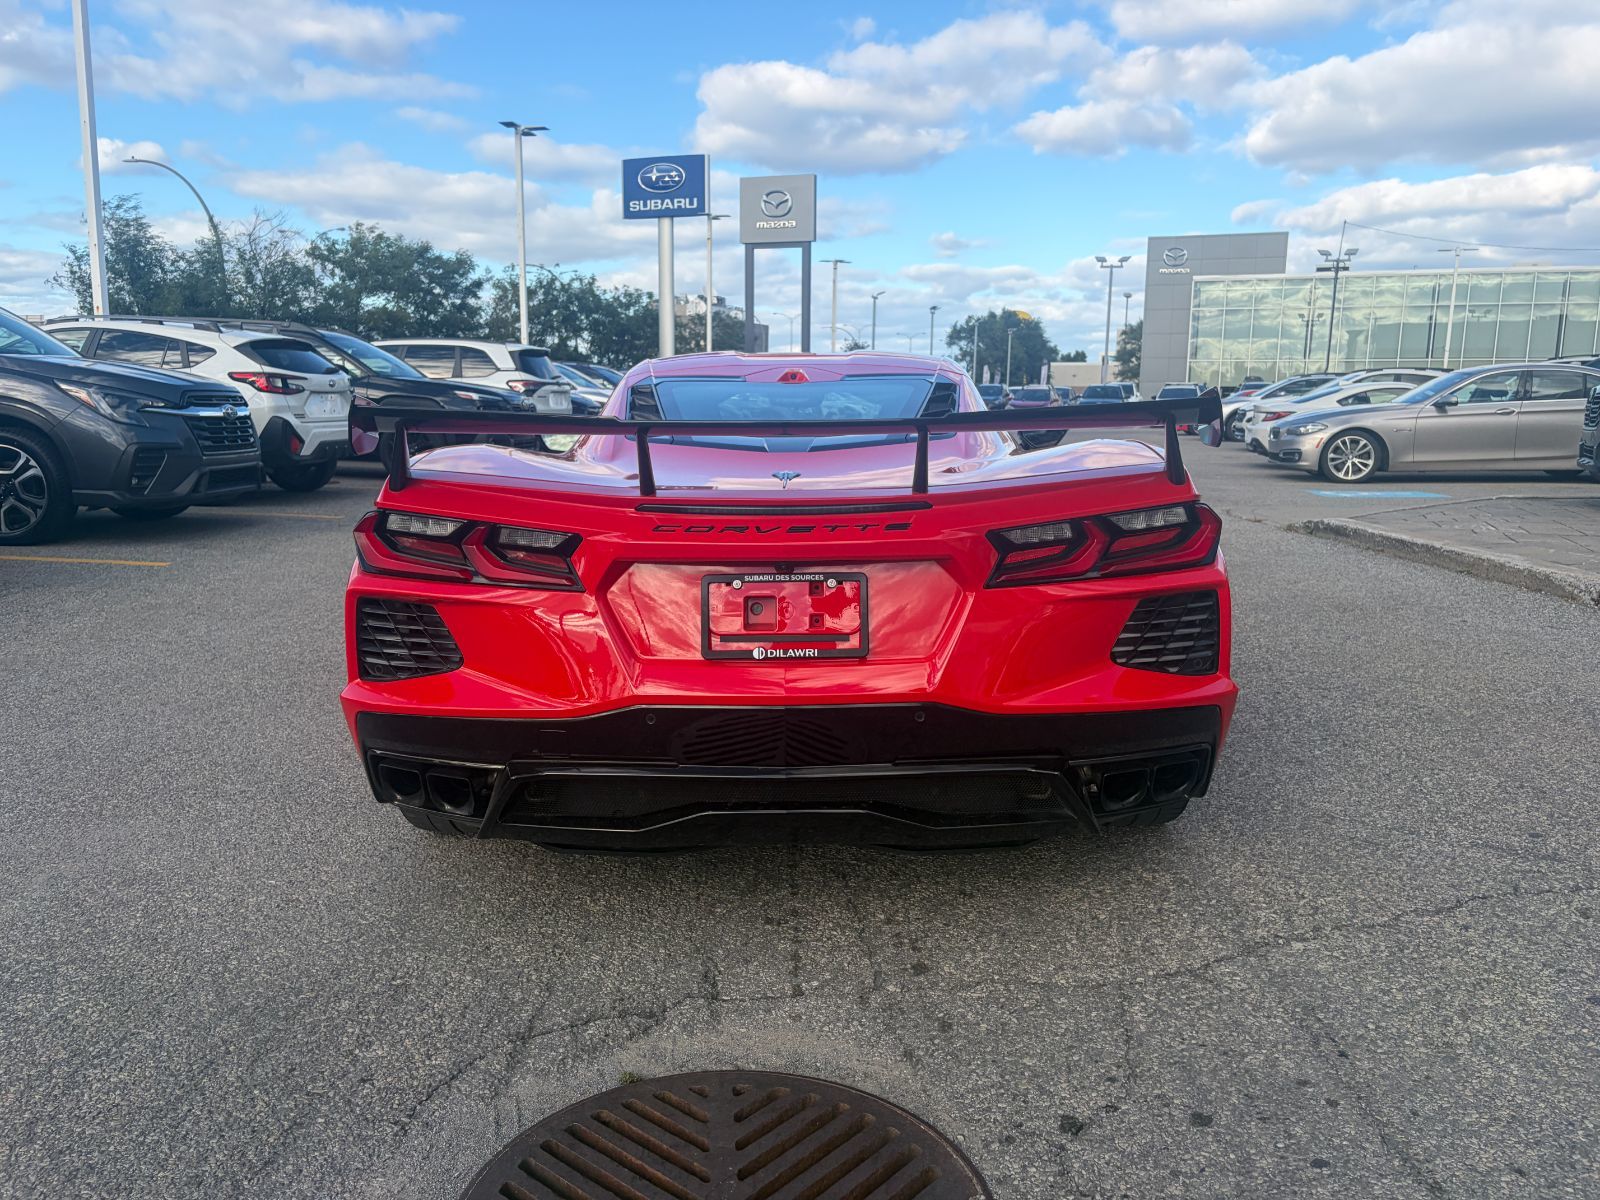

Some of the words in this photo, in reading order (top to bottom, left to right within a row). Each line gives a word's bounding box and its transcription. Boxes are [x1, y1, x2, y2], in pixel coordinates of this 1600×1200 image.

[629, 197, 698, 212] SUBARU
[756, 220, 797, 229] mazda
[652, 522, 913, 535] CORVETTE
[744, 574, 774, 582] SUBARU
[775, 574, 790, 582] DES
[767, 648, 818, 658] DILAWRI
